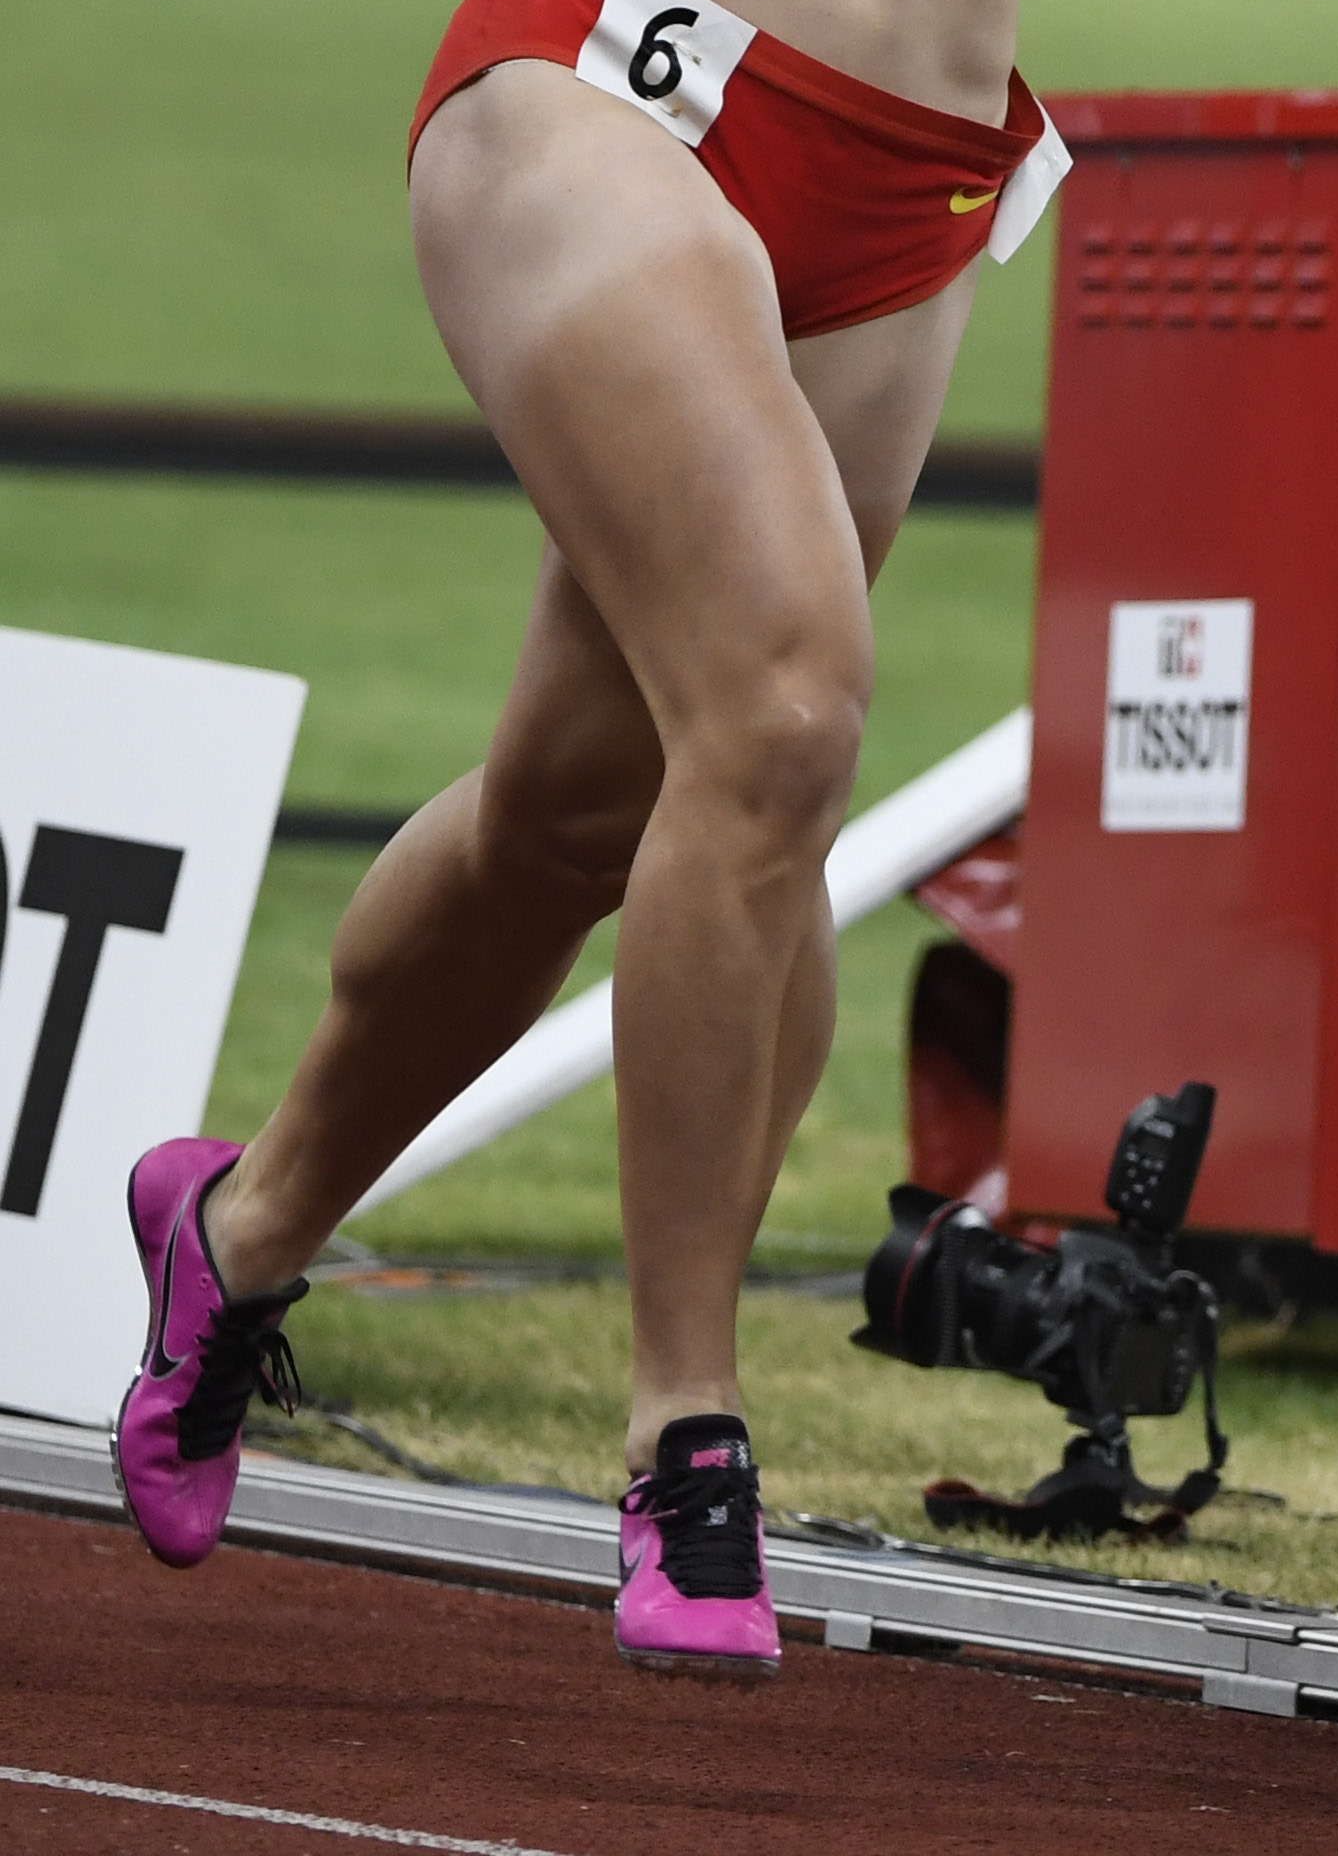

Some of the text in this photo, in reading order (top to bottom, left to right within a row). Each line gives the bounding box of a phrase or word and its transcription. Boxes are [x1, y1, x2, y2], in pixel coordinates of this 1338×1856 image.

[628, 7, 700, 101] 6
[1110, 701, 1246, 773] TISSOT
[0, 822, 186, 1218] T
